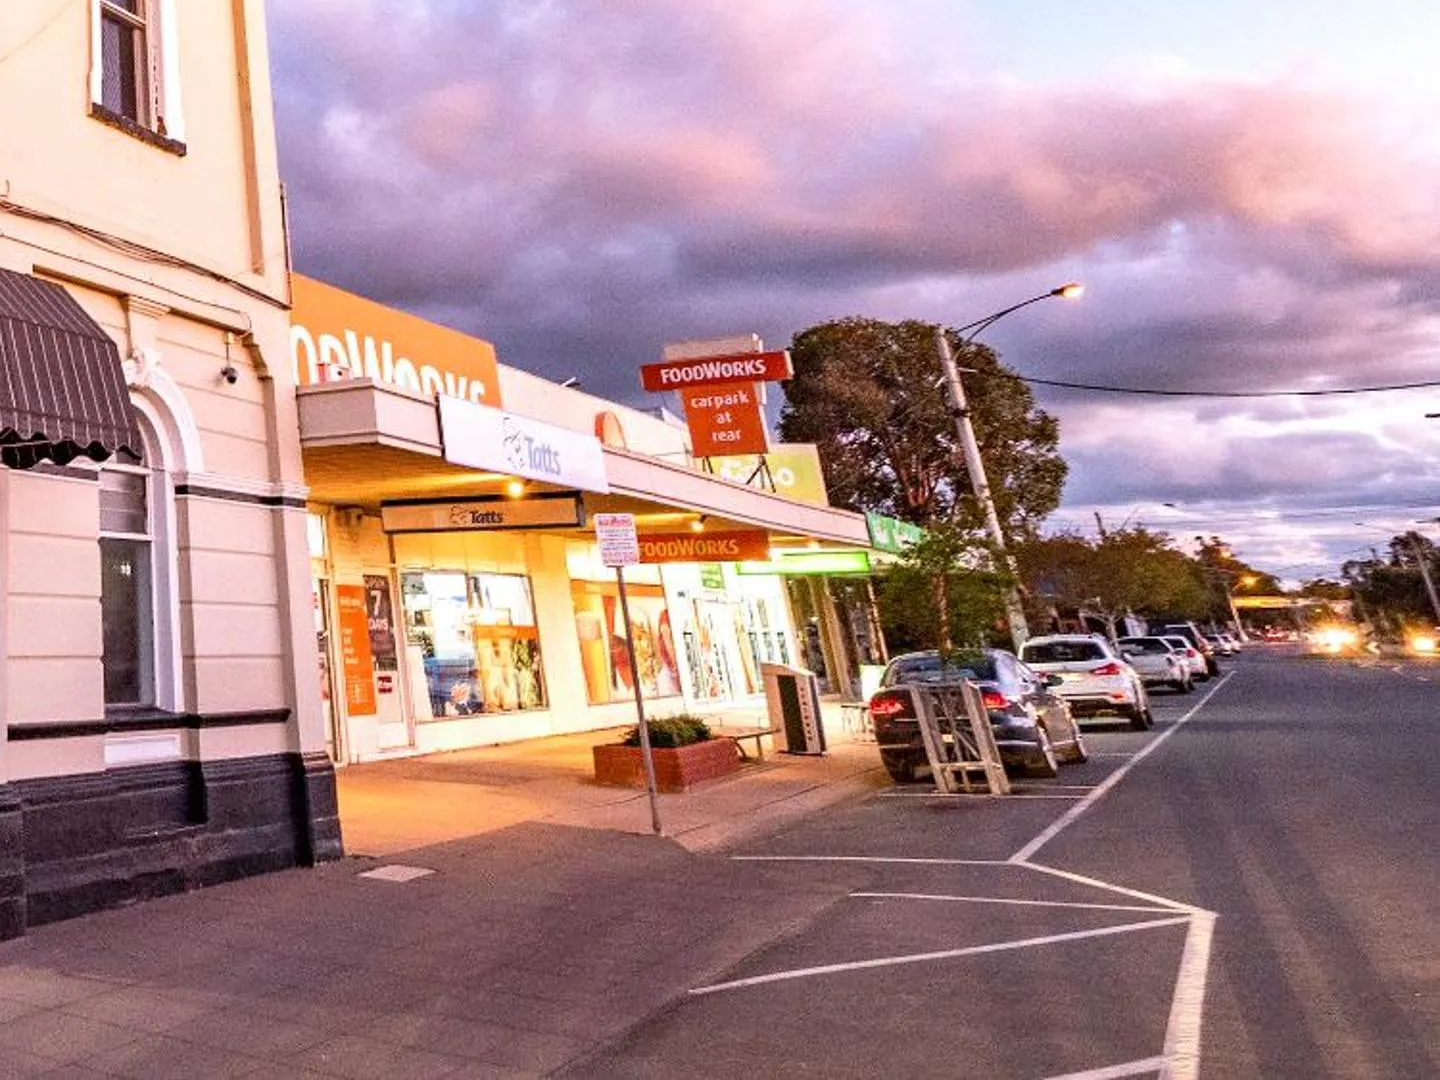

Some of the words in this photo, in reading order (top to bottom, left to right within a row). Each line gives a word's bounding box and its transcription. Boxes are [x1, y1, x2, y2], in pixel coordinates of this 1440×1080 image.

[660, 359, 767, 384] FOODWORKS
[690, 390, 750, 409] carpark
[716, 412, 732, 424] at
[711, 428, 742, 442] rear
[523, 436, 561, 476] Tatts
[469, 510, 504, 524] Tatts
[370, 590, 382, 617] 7
